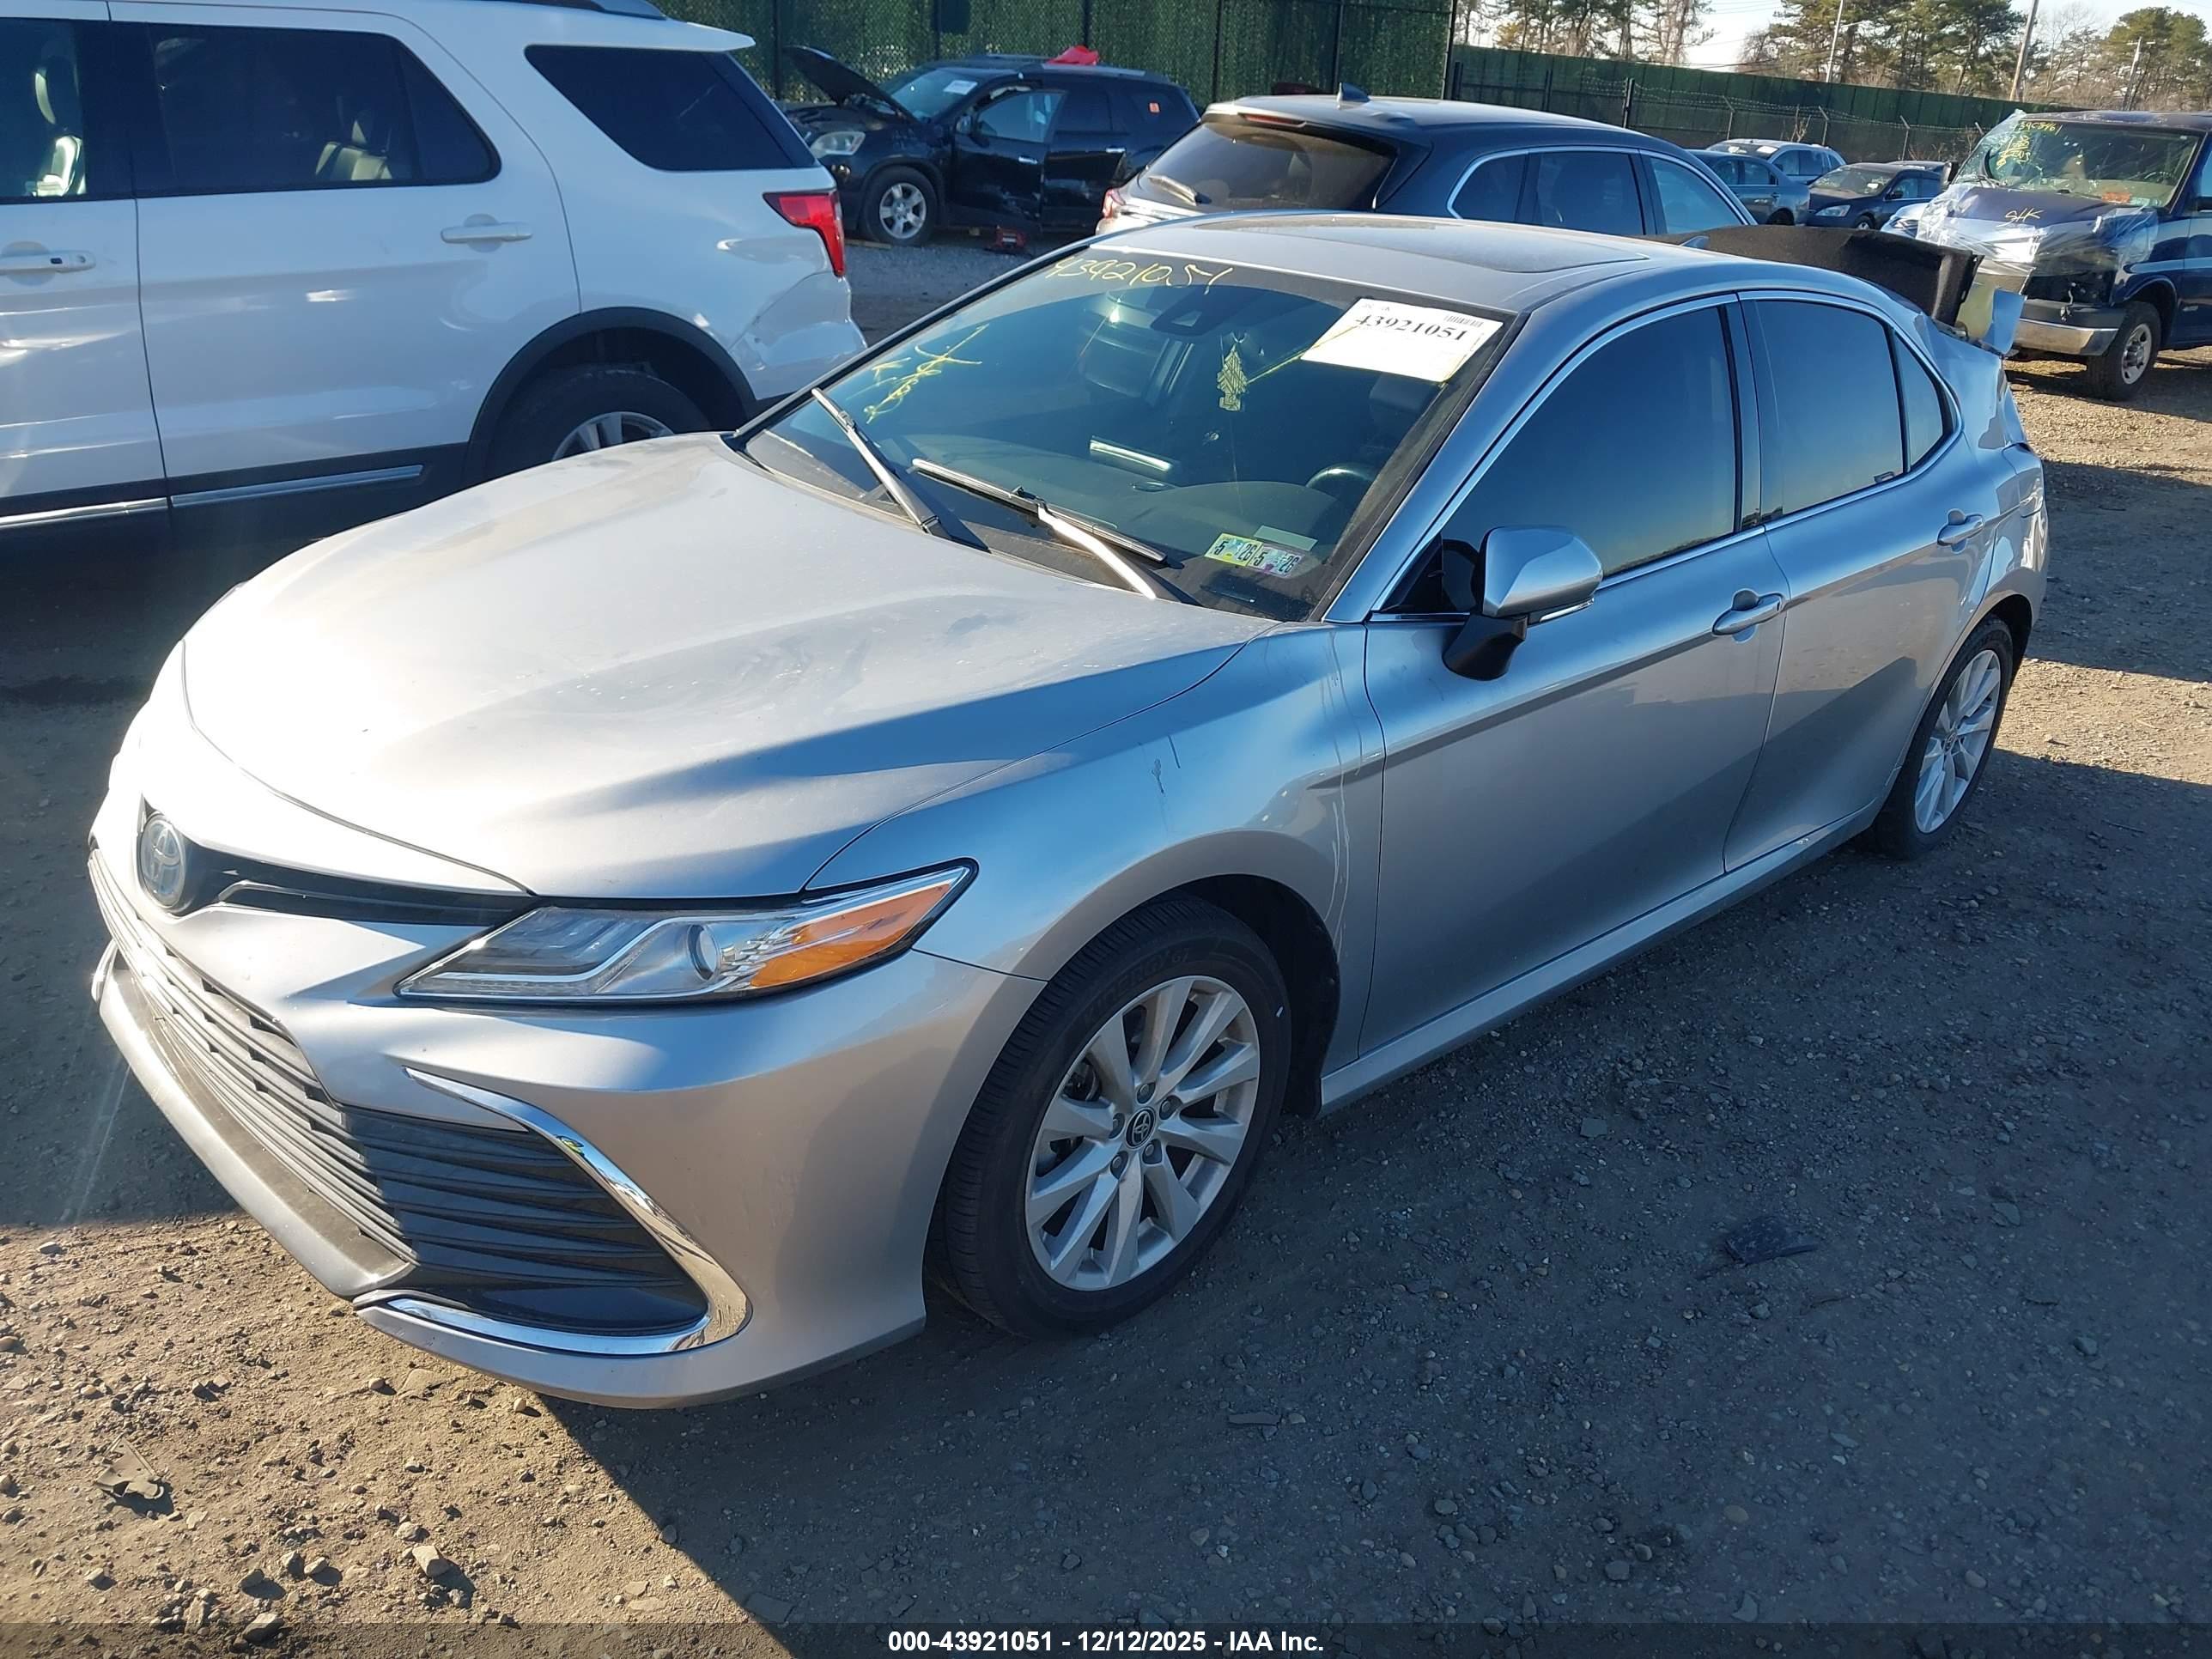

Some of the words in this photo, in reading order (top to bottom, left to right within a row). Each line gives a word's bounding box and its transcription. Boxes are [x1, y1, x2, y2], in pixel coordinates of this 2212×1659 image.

[1355, 314, 1469, 341] 43921051
[1237, 544, 1257, 561] 26
[1279, 555, 1299, 573] 26
